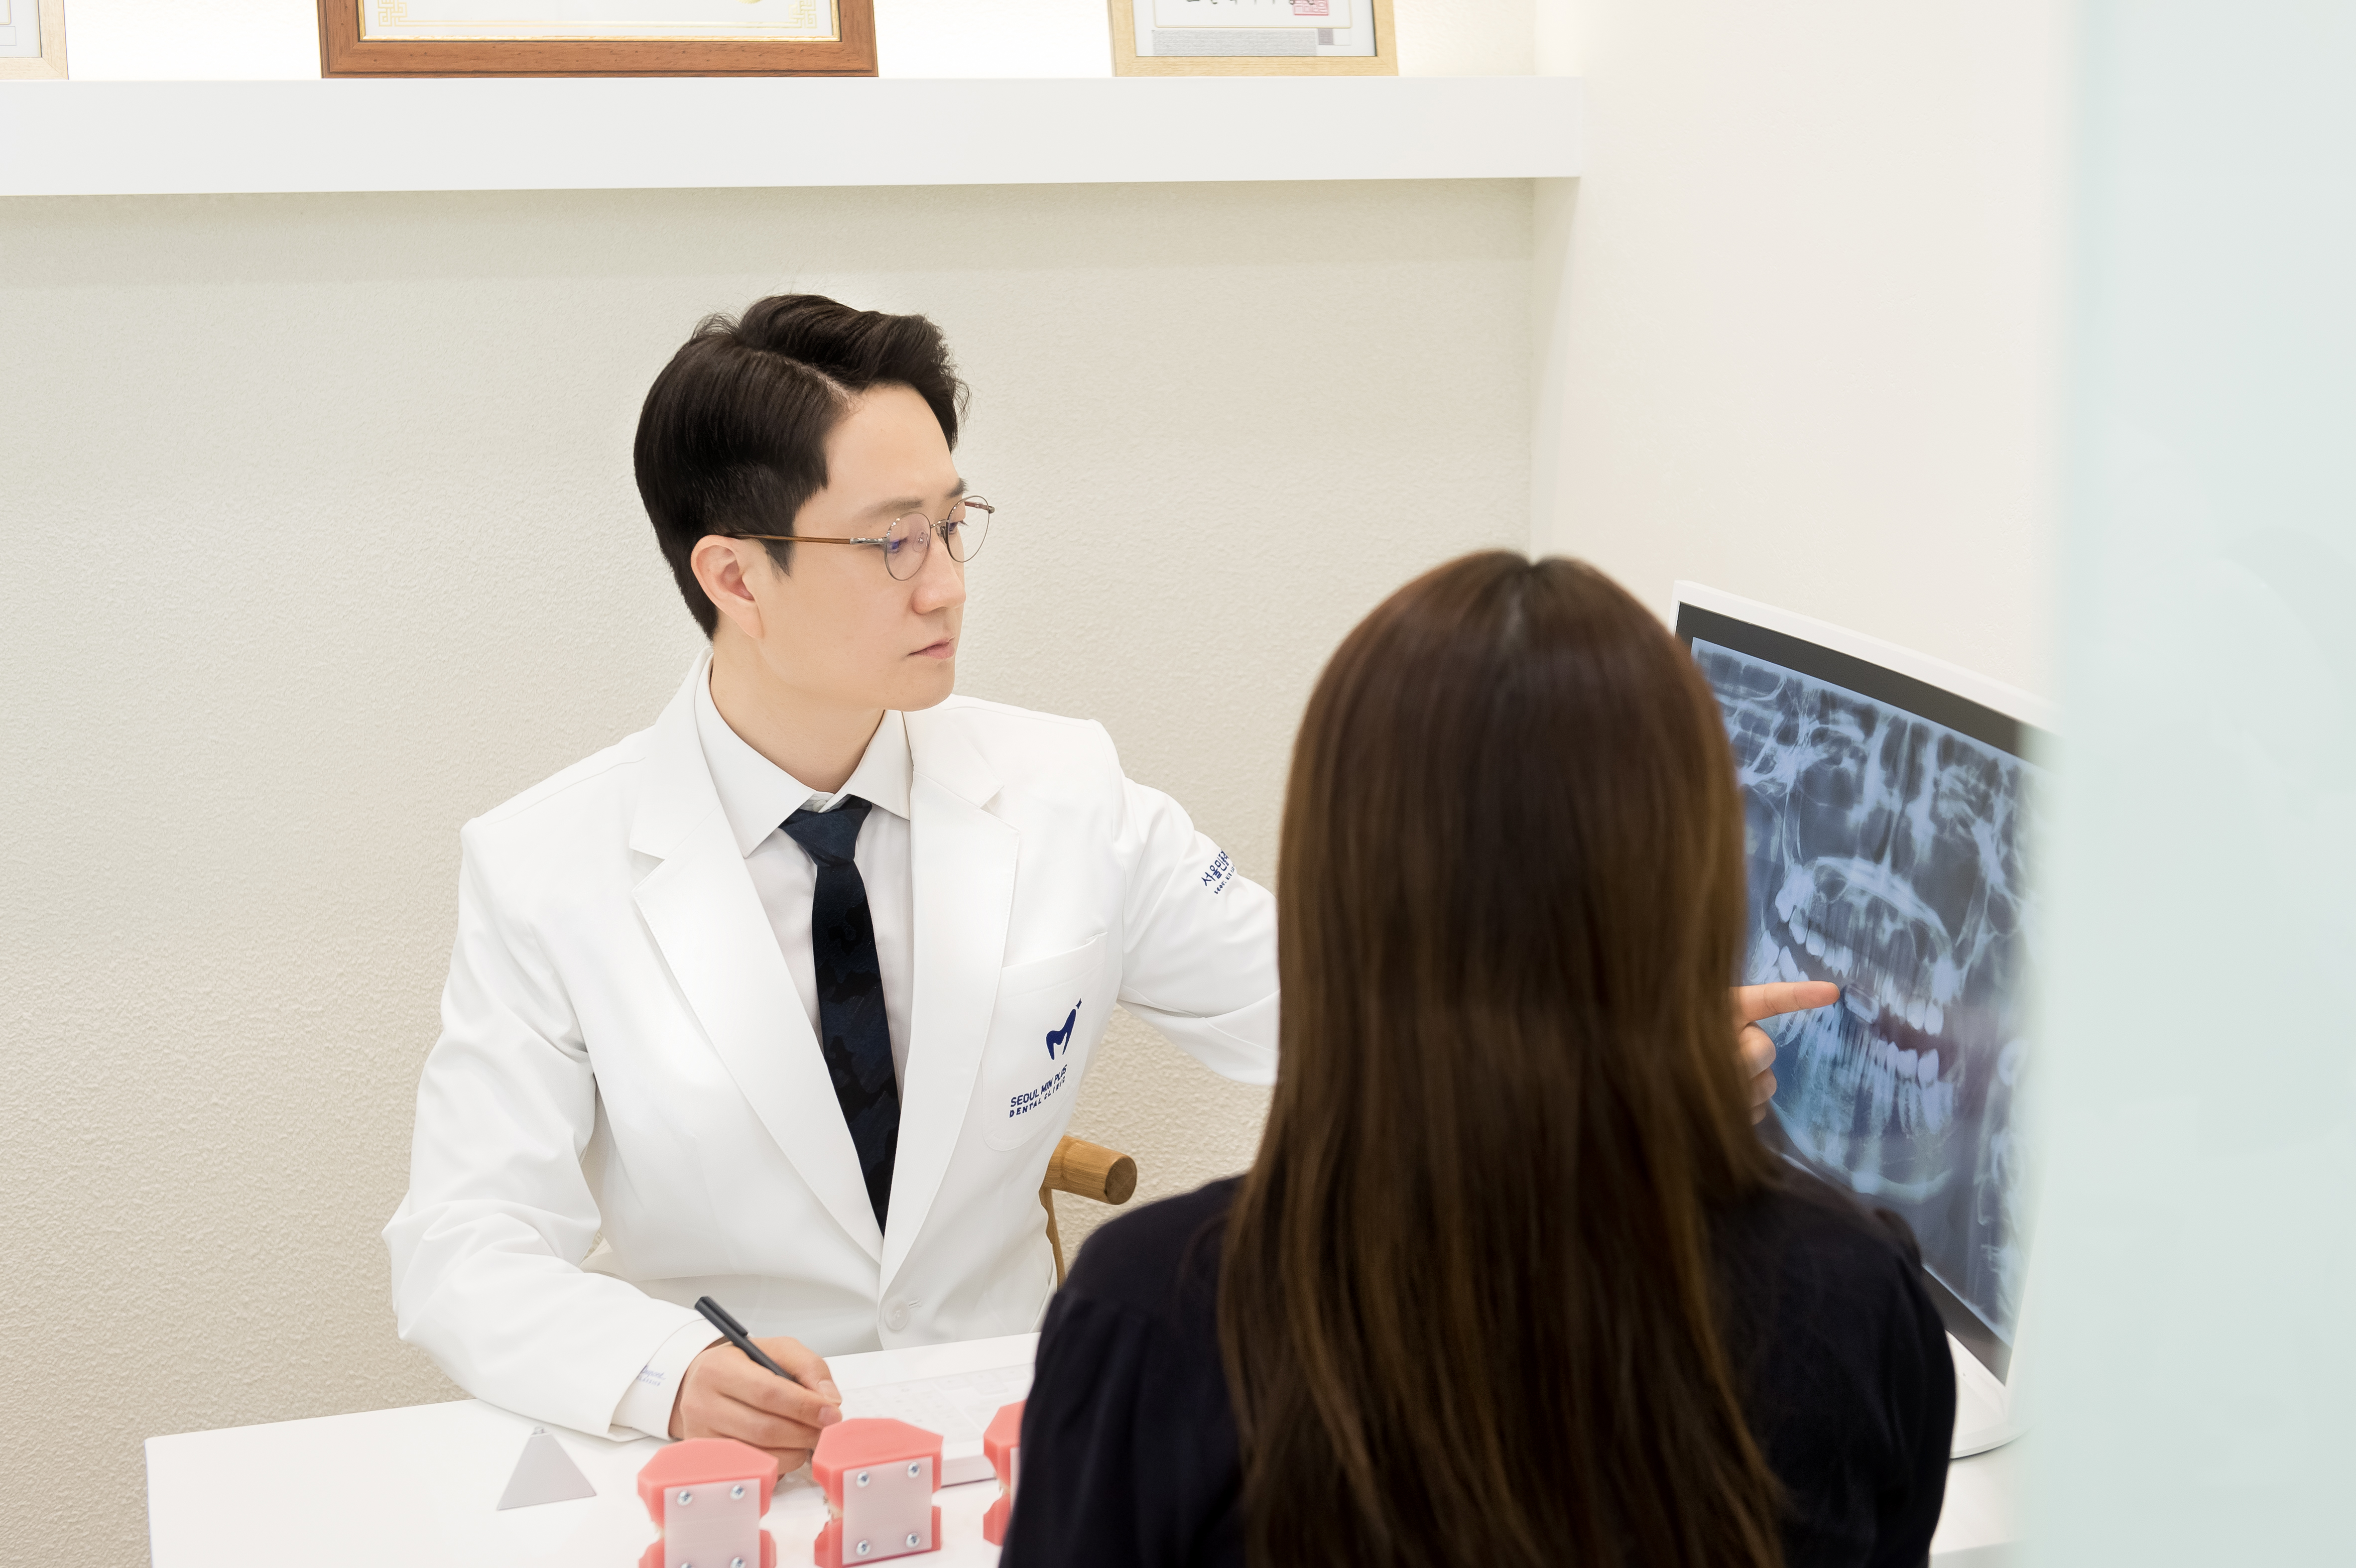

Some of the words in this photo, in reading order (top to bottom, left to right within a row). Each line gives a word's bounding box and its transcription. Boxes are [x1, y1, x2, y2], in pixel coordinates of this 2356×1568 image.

[1009, 1097, 1042, 1118] DENTAL
[1044, 1076, 1065, 1100] CLINIC
[1010, 1088, 1039, 1107] SEOUL
[1041, 1078, 1053, 1094] MIN
[1054, 1064, 1068, 1085] PLUS
